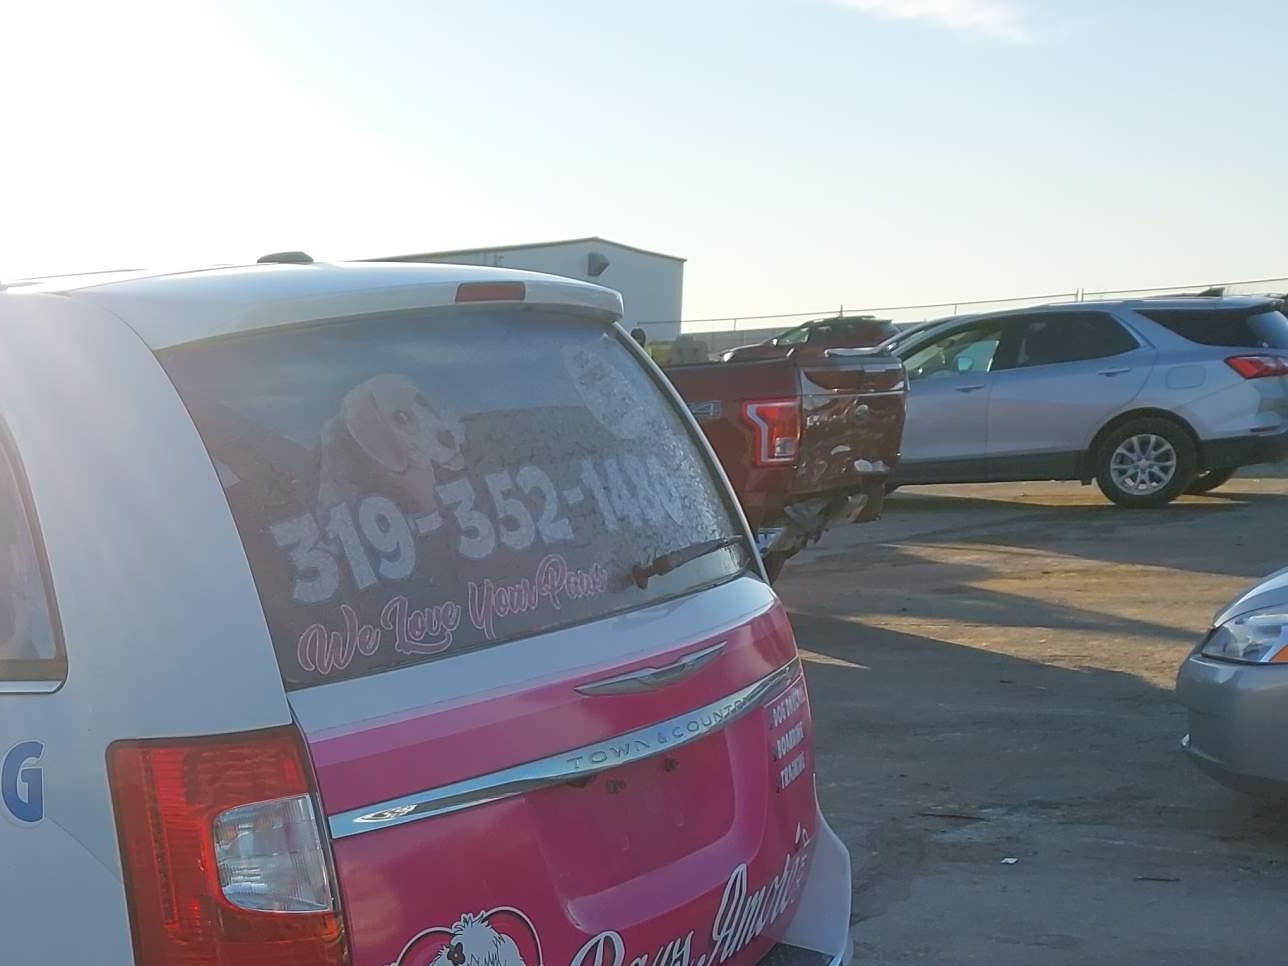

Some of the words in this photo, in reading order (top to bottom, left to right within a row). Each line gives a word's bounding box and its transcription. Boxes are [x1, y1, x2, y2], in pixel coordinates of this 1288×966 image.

[297, 604, 380, 674] We
[380, 595, 460, 655] Love
[467, 578, 538, 640] Your
[535, 553, 608, 610] Paws
[567, 739, 651, 770] TOWN
[656, 732, 668, 744] &
